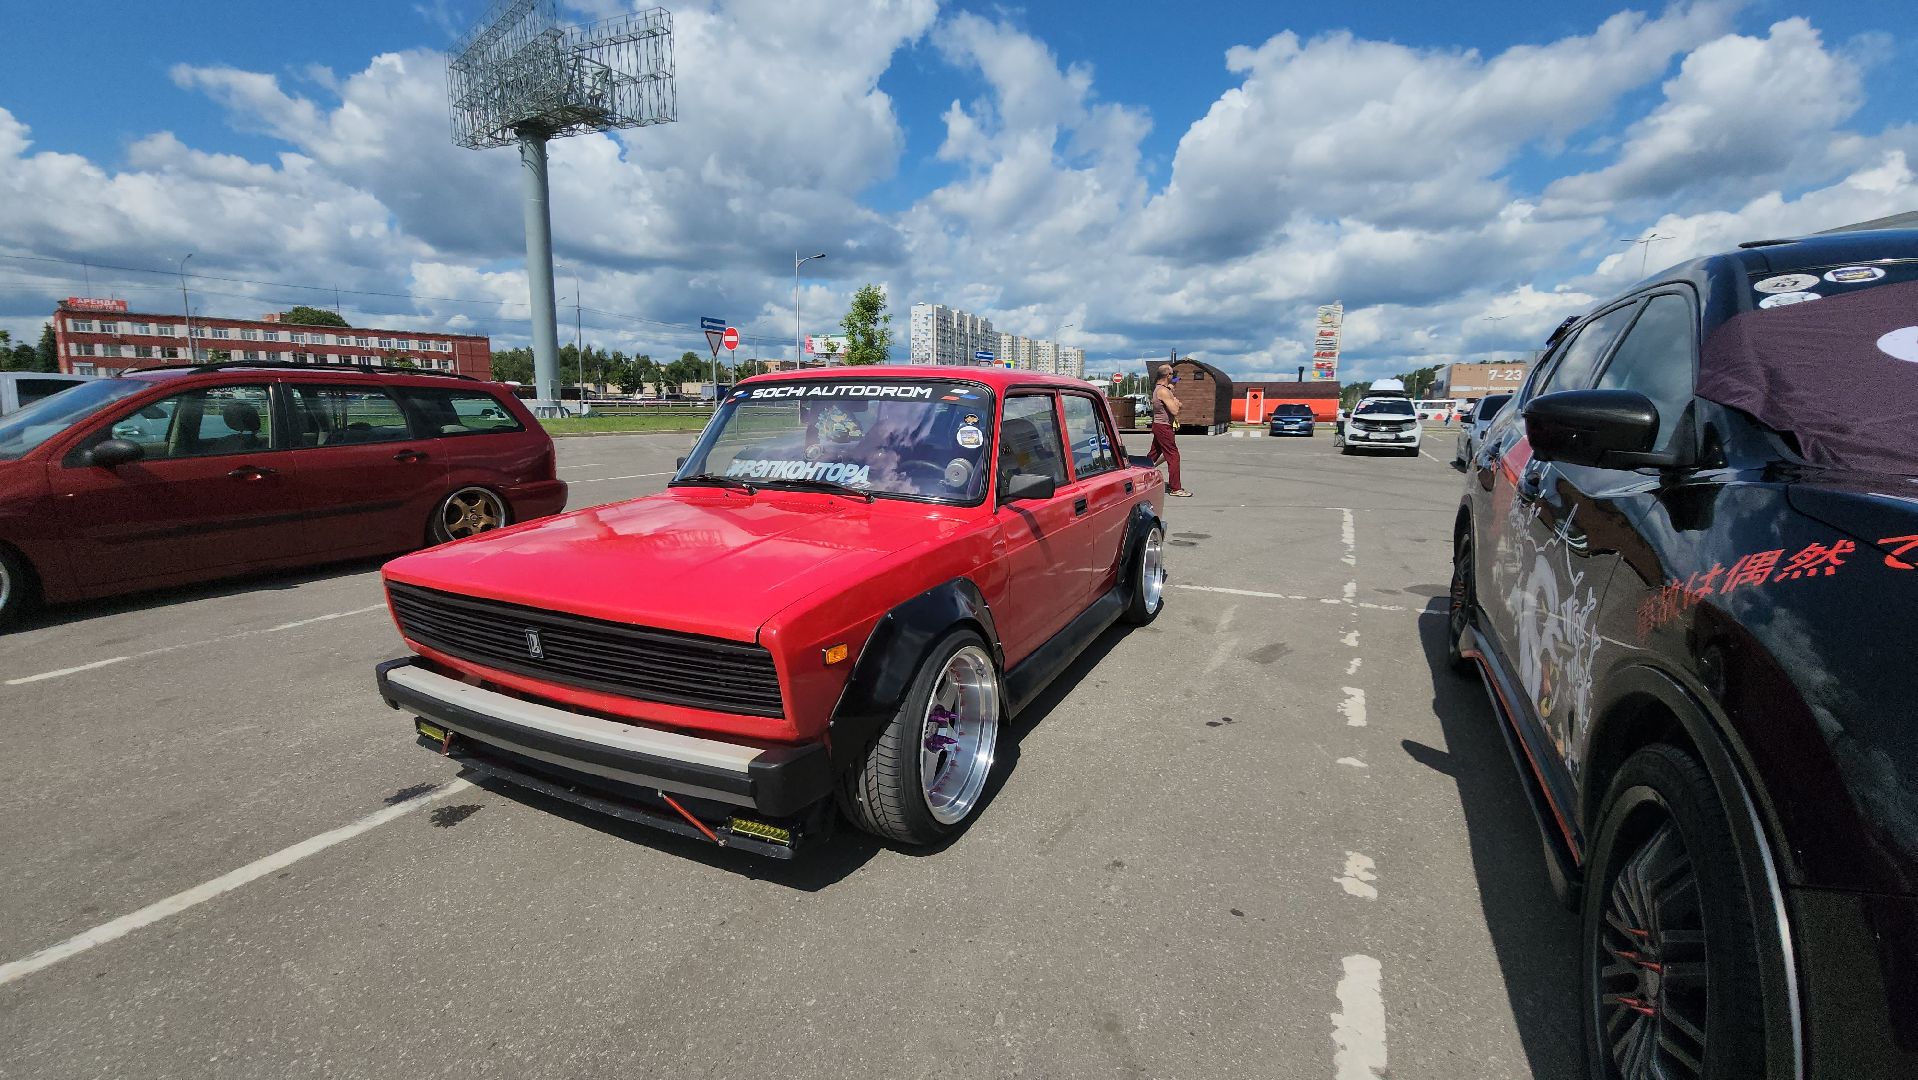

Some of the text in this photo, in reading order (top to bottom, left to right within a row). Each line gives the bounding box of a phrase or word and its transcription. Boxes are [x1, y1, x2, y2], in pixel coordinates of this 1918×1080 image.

[77, 298, 118, 306] АРЕНДА
[1488, 369, 1523, 381] 7-23
[750, 385, 932, 399] SOCHI AUTODROM
[725, 459, 870, 483] #РЭПКОНТОРА
